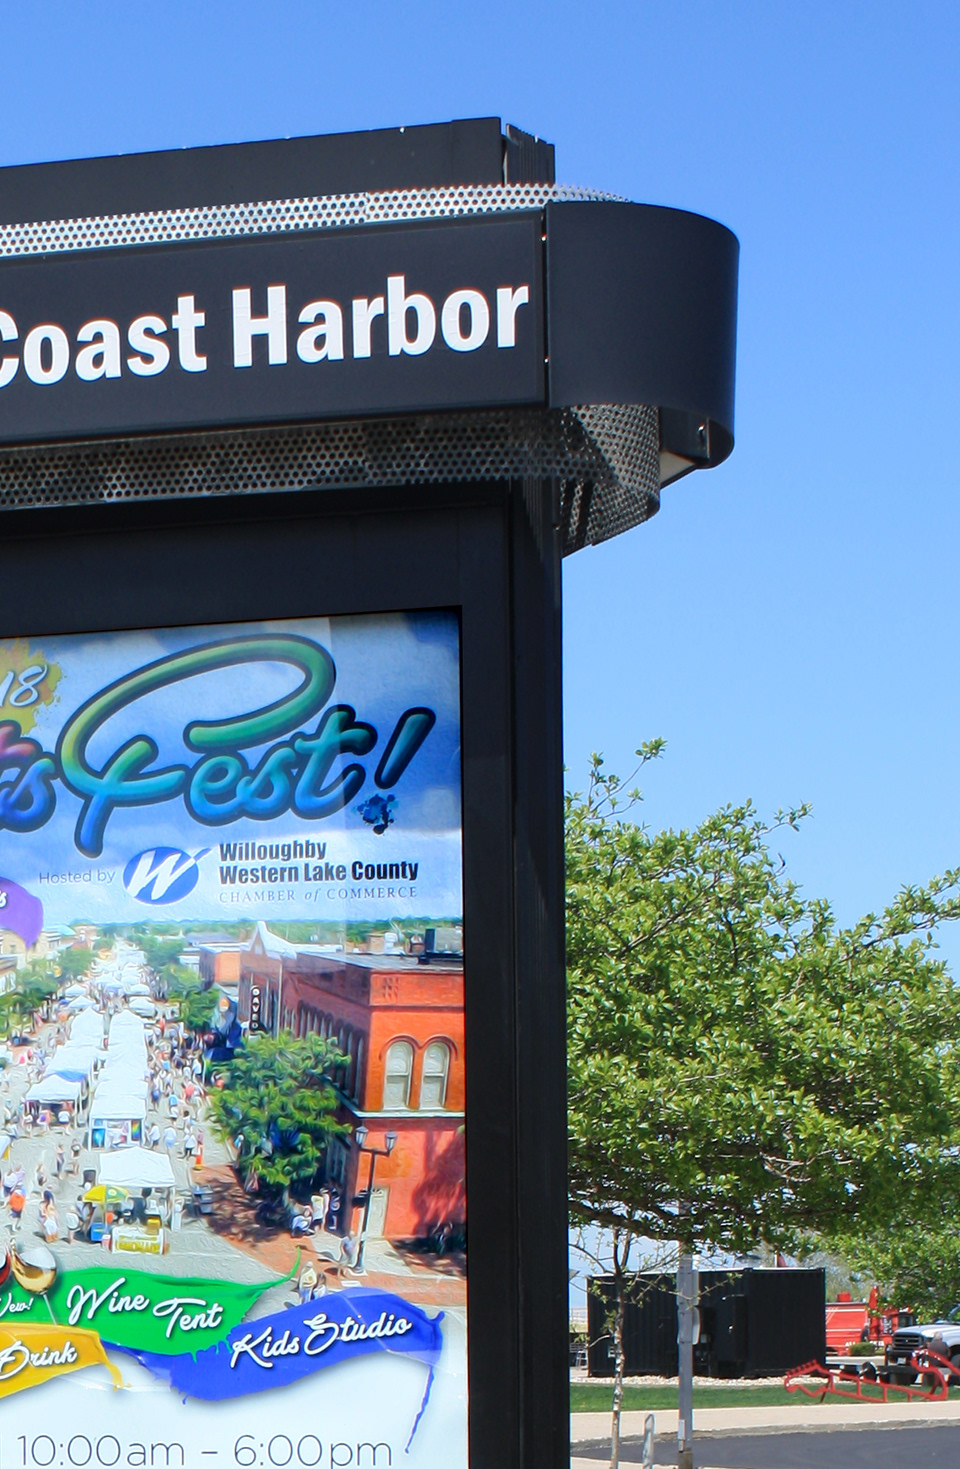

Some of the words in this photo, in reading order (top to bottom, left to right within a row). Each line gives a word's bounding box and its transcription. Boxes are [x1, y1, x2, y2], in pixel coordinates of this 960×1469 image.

[232, 274, 529, 368] Harbor
[219, 840, 327, 861] Willoughby
[39, 870, 92, 884] Hosted
[97, 869, 116, 884] by
[219, 863, 299, 885] Western
[304, 862, 347, 881] Lake
[351, 861, 419, 882] County
[219, 889, 296, 902] CHAMBER
[305, 888, 321, 901] of
[326, 886, 418, 899] COMMERCE
[67, 1278, 149, 1325] Wine
[153, 1297, 223, 1338] Tent
[230, 1326, 300, 1369] Kids
[303, 1313, 413, 1355] Studio
[17, 1434, 185, 1467] 10:00am
